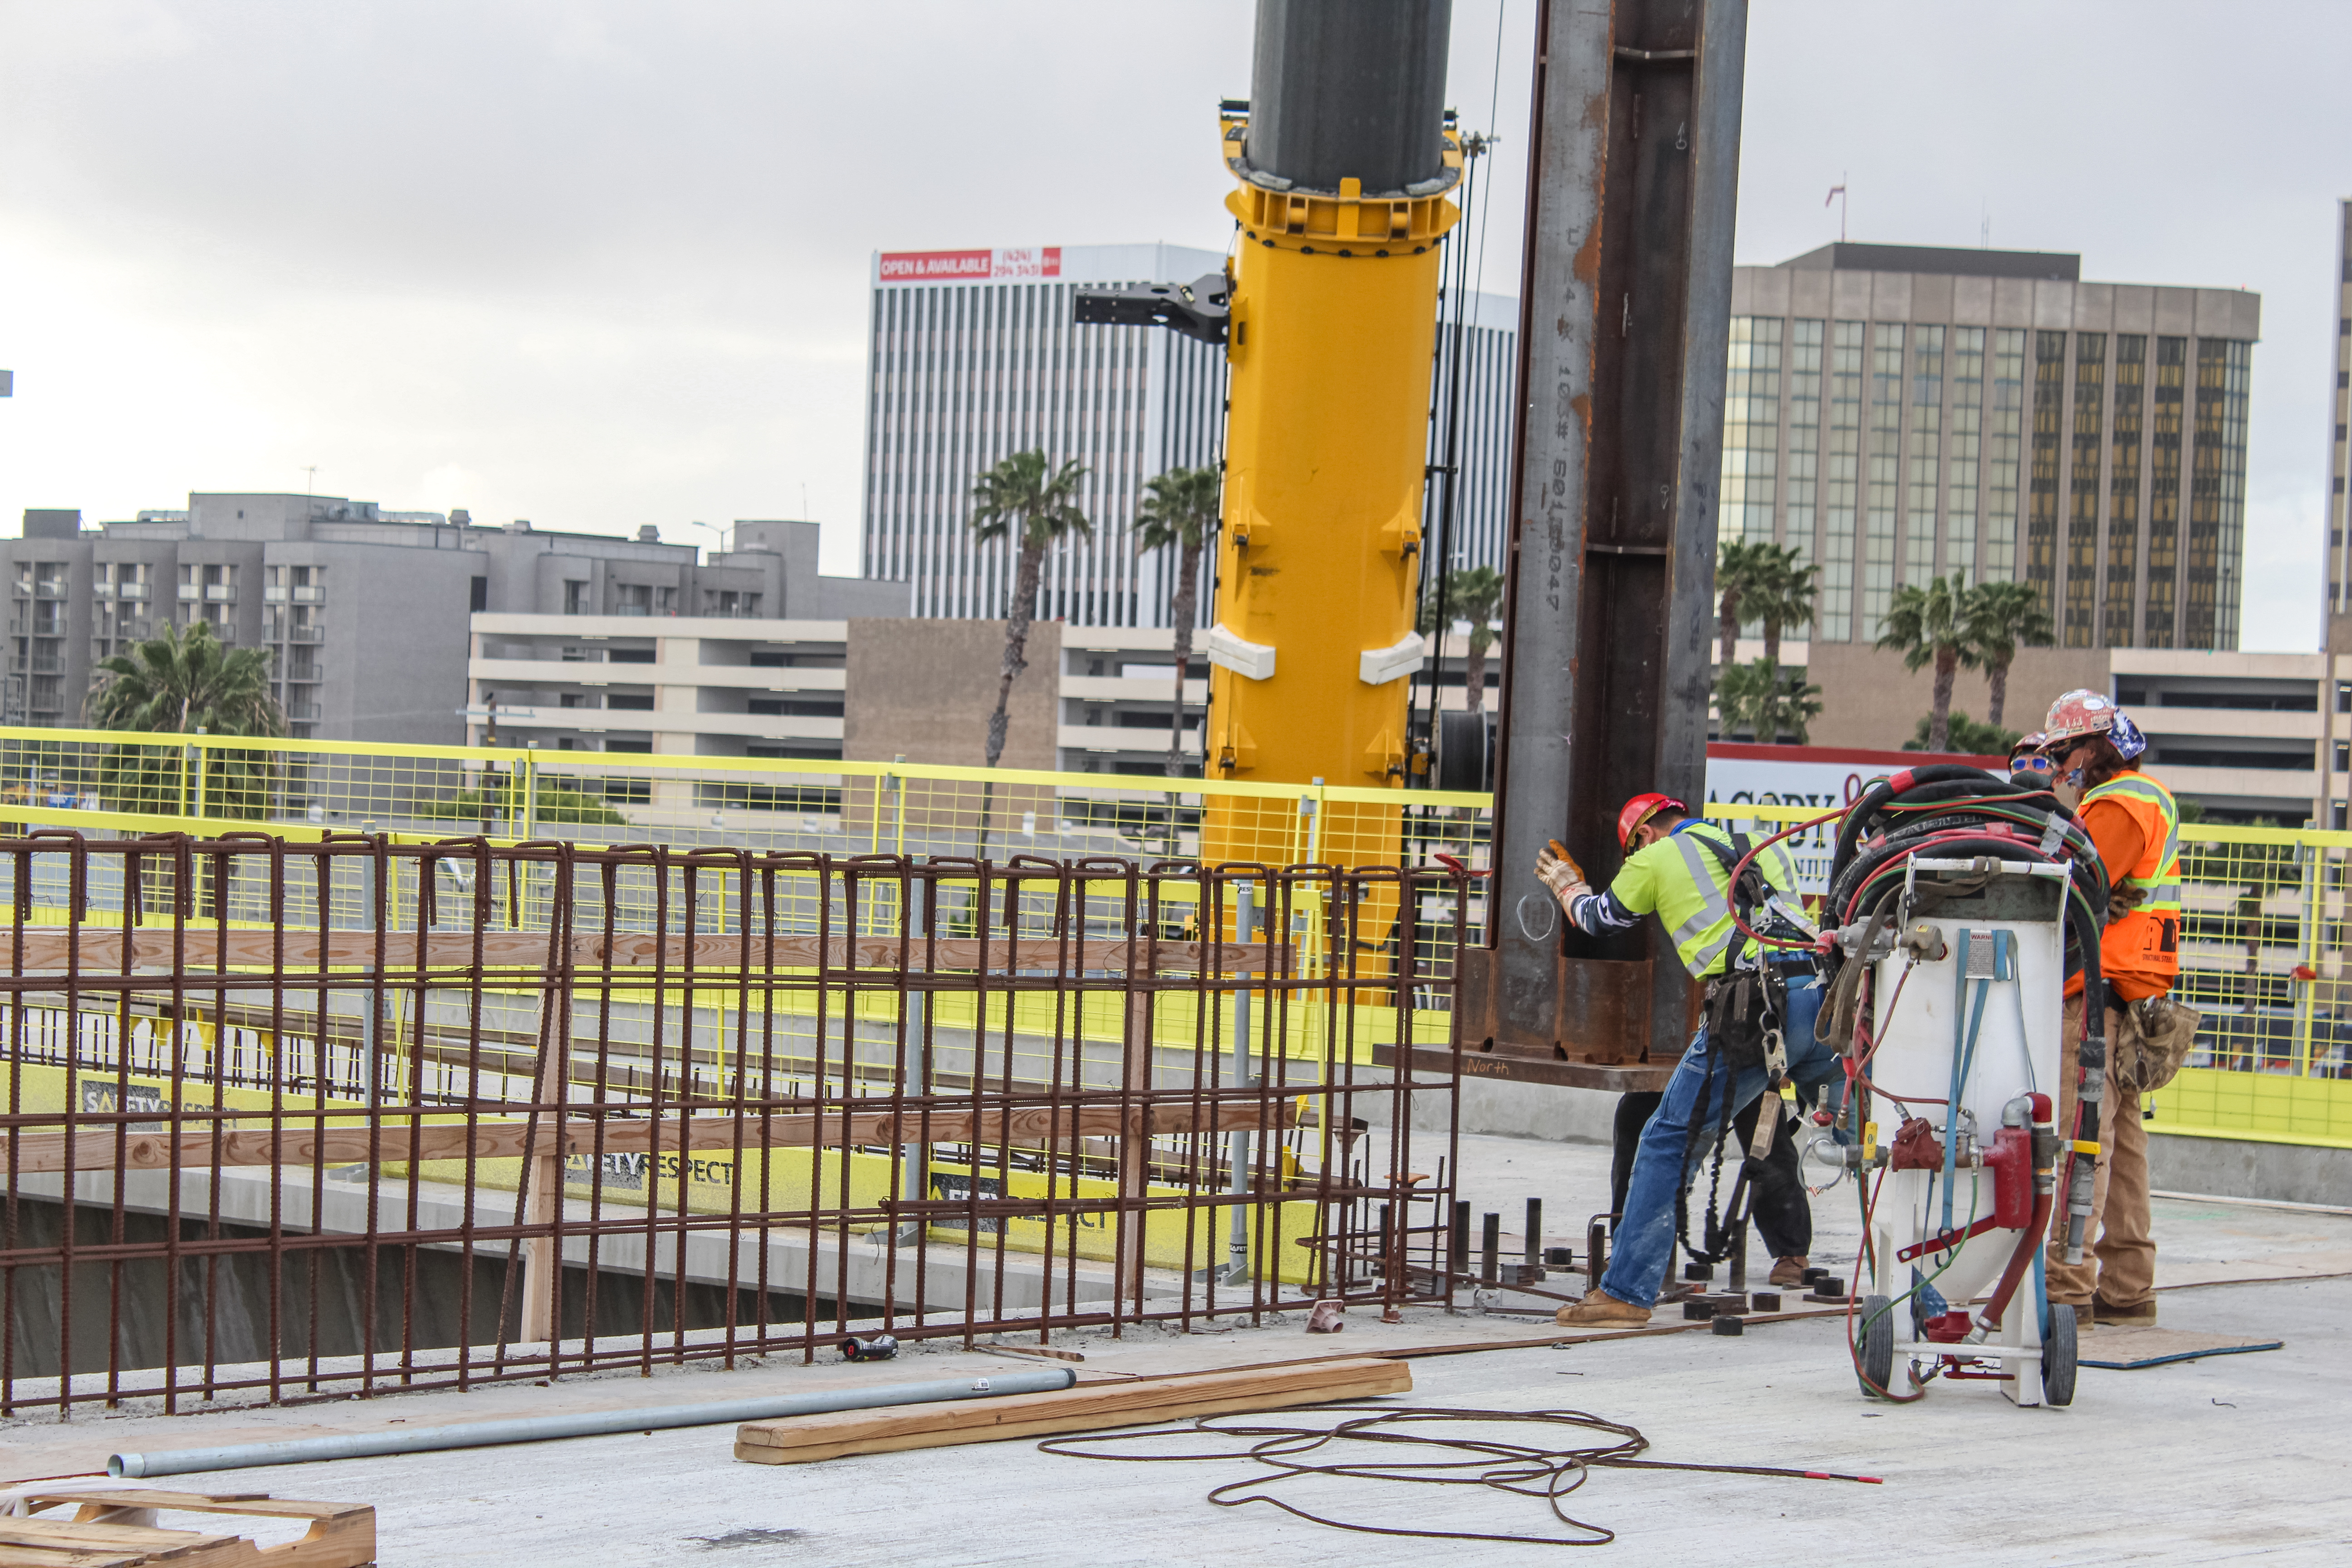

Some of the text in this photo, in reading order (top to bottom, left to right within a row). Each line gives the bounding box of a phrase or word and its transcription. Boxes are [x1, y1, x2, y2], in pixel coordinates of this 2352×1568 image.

[881, 257, 990, 275] OPEN & AVAILABLE
[1467, 1058, 1509, 1075] North
